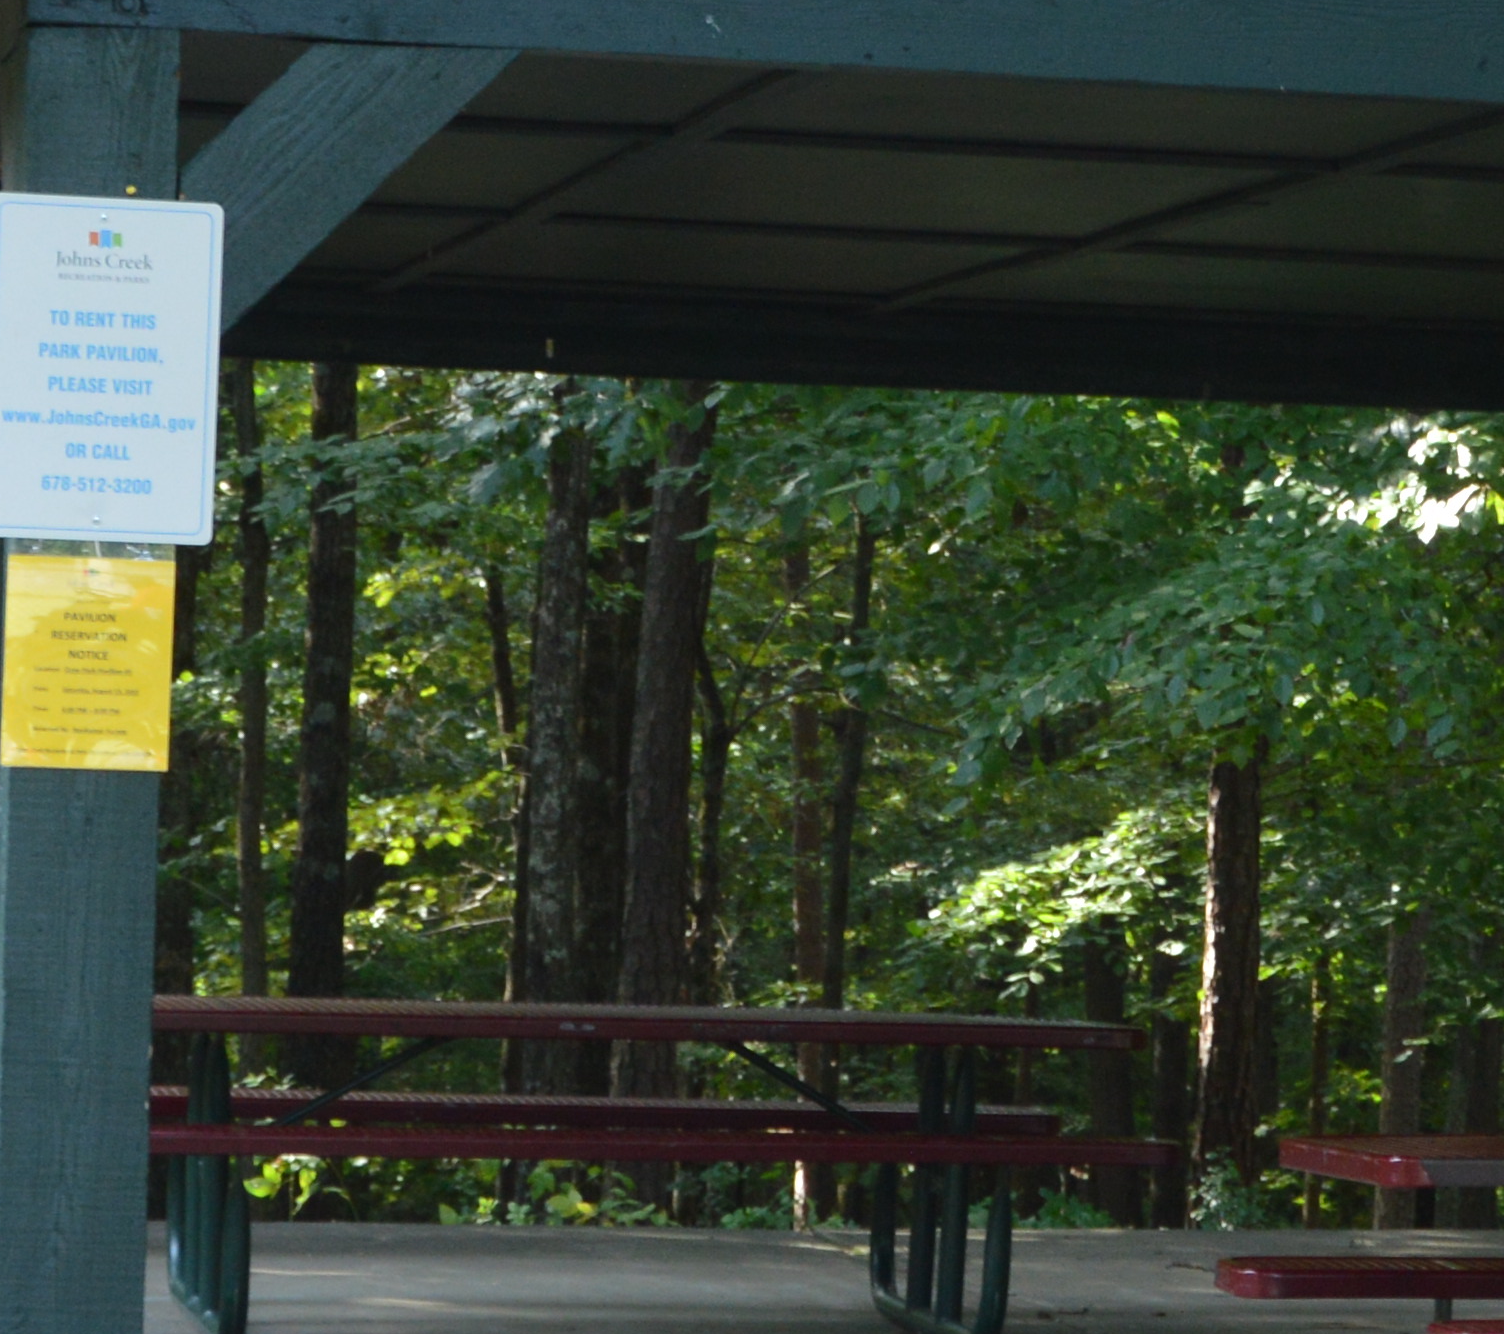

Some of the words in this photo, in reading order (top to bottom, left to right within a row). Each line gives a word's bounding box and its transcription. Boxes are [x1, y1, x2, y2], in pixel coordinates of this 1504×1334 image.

[56, 250, 101, 268] Johns
[105, 252, 153, 271] Creek
[49, 309, 69, 326] TO
[75, 311, 115, 328] RENT
[122, 312, 157, 330] THIS
[38, 342, 81, 359] PARK
[48, 376, 107, 393] PLEASE
[112, 378, 153, 396] VISIT
[2, 409, 196, 433] www.JohnsCreekGA.gov
[65, 443, 86, 458] OR
[92, 444, 131, 461] CALL
[41, 475, 152, 495] 678-512-3200
[63, 611, 116, 623] PAVILION
[51, 630, 127, 642] RESERVATION
[68, 650, 108, 660] NOTICE
